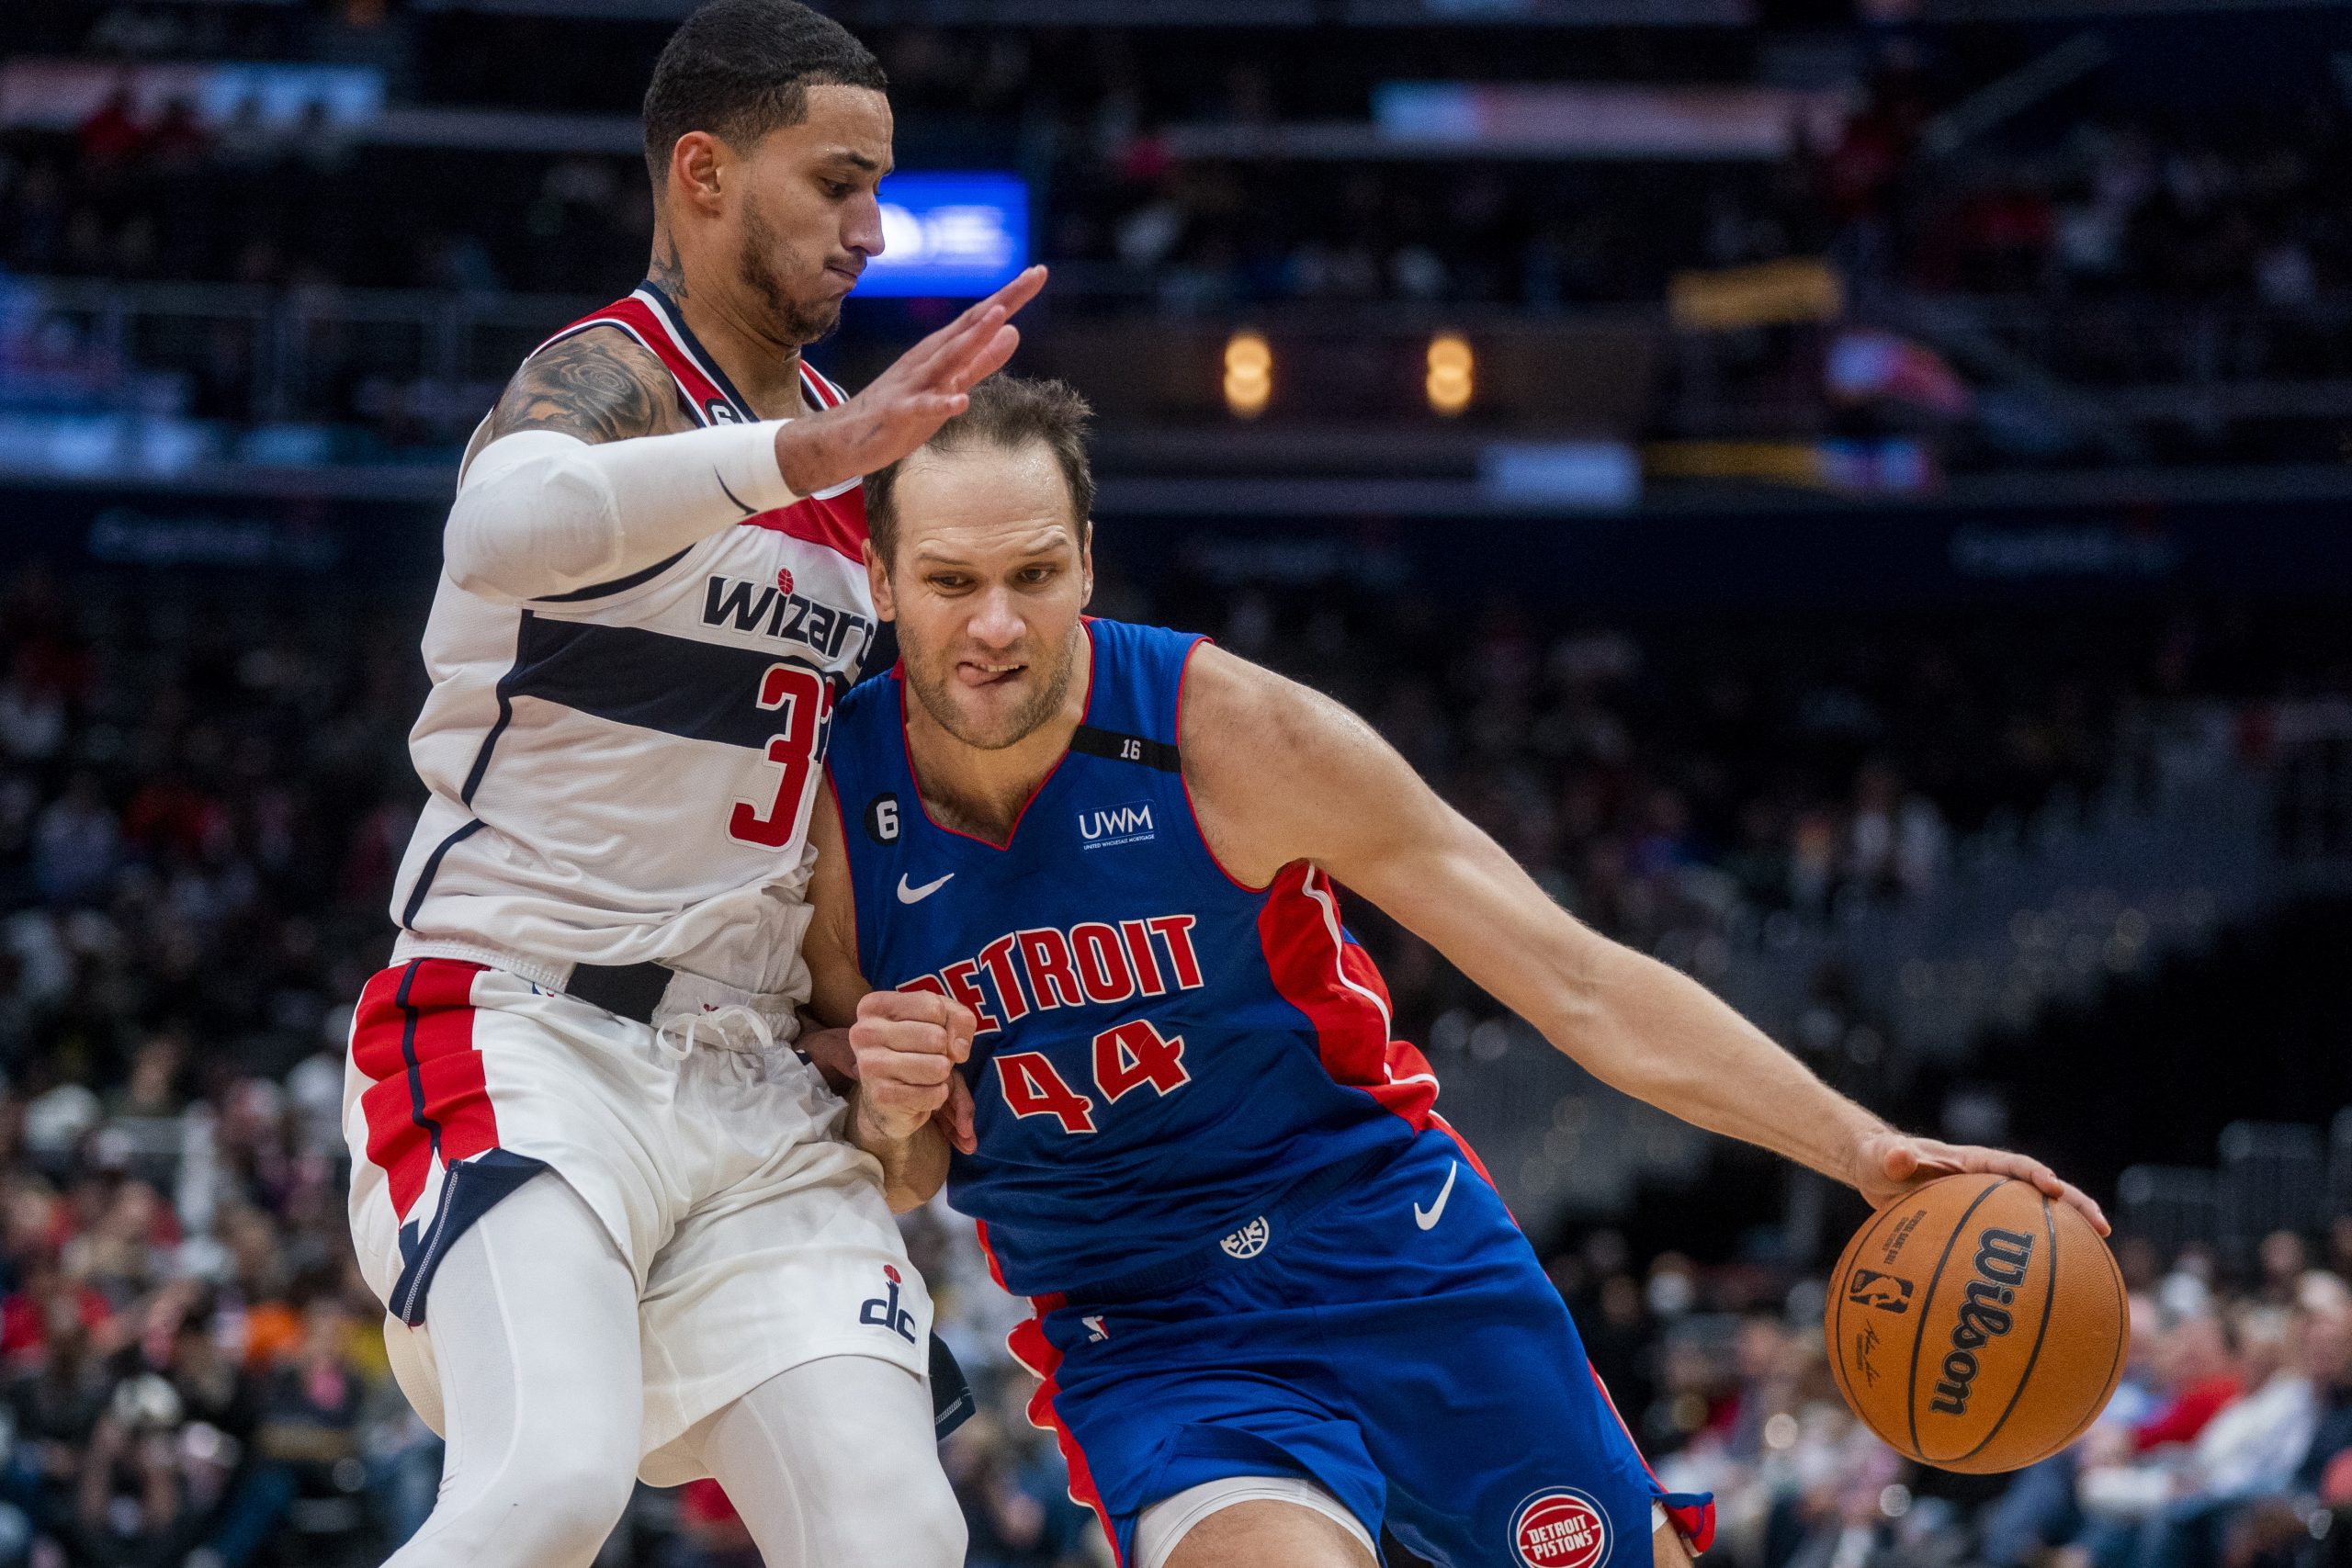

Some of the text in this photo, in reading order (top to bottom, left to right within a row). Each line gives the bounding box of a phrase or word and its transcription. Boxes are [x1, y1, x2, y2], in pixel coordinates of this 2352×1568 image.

[1120, 739, 1141, 761] 16
[876, 799, 899, 840] 6
[1079, 805, 1154, 840] UWM
[1084, 834, 1155, 851] UNITED WHOLESALE MORTGAGE
[993, 1019, 1192, 1134] 44
[1929, 1227, 2035, 1416] Wilson
[1527, 1514, 1587, 1544] DETROIT
[1532, 1529, 1593, 1561] PISTONS
